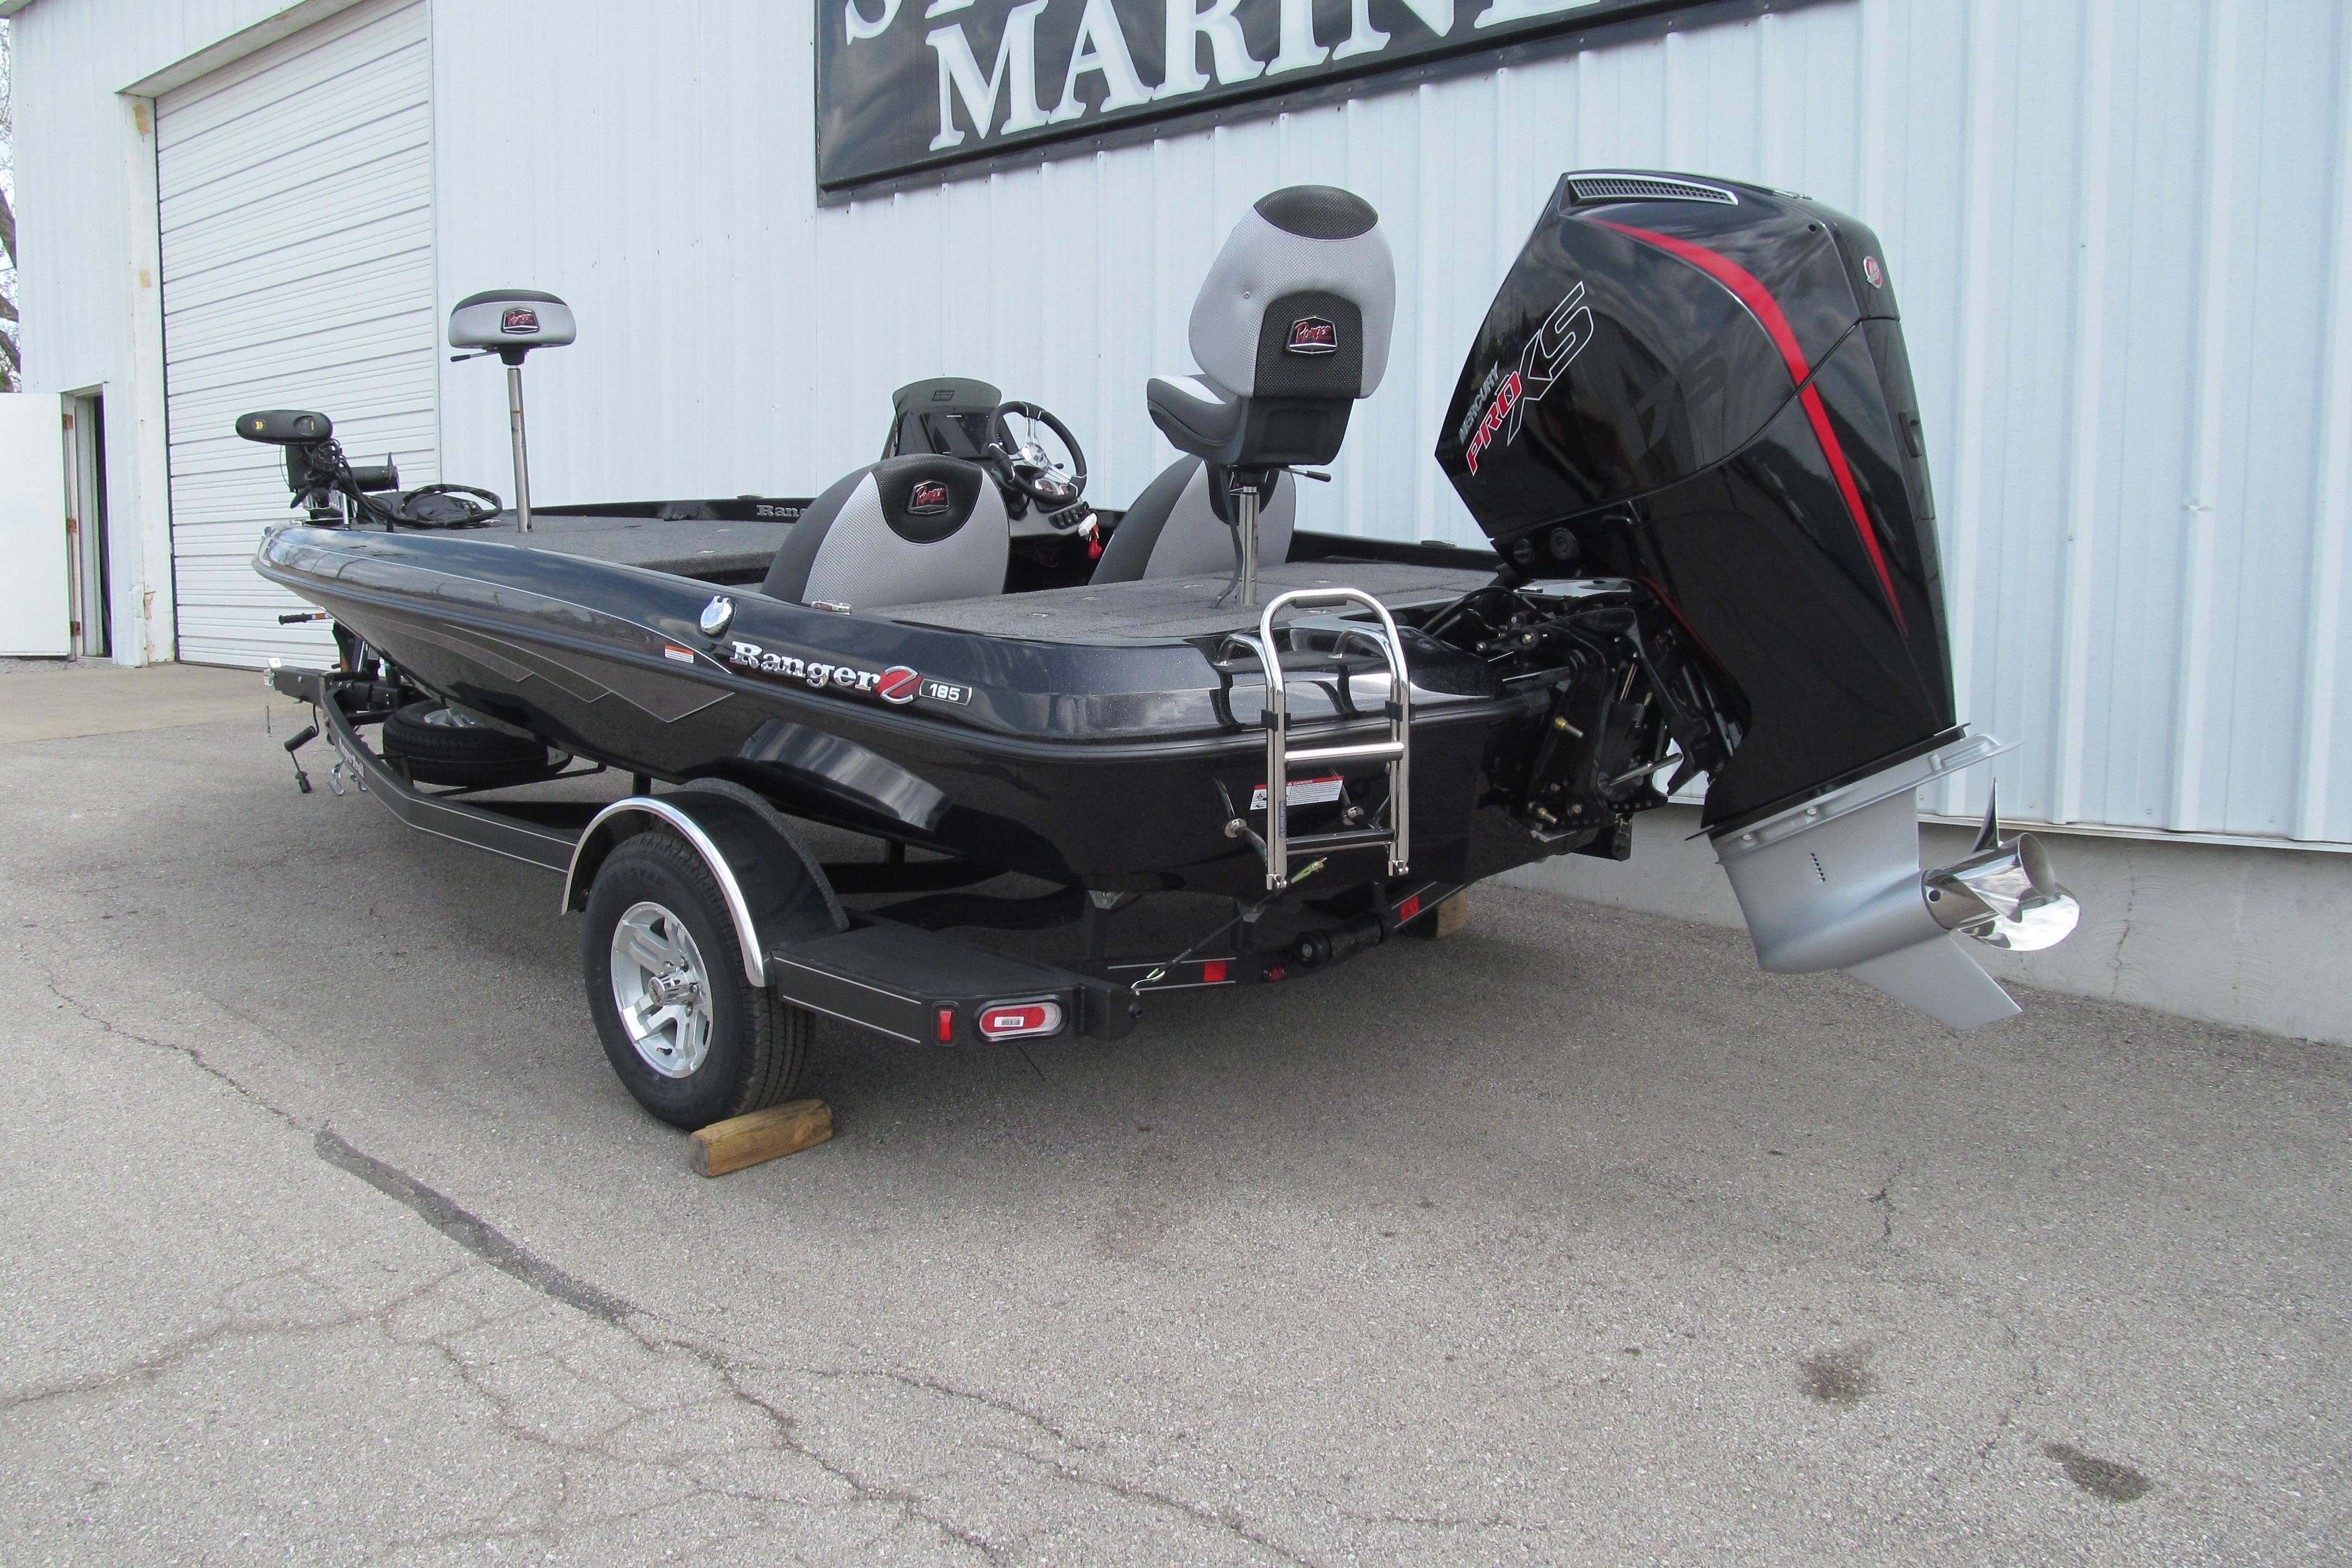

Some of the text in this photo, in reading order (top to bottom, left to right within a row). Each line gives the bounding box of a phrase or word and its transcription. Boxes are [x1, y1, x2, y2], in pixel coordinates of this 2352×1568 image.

[926, 0, 1602, 151] MARI
[1459, 360, 1500, 445] MERCURY
[1466, 280, 1594, 476] PRO XS
[729, 641, 881, 692] Ranger
[929, 683, 960, 701] 185
